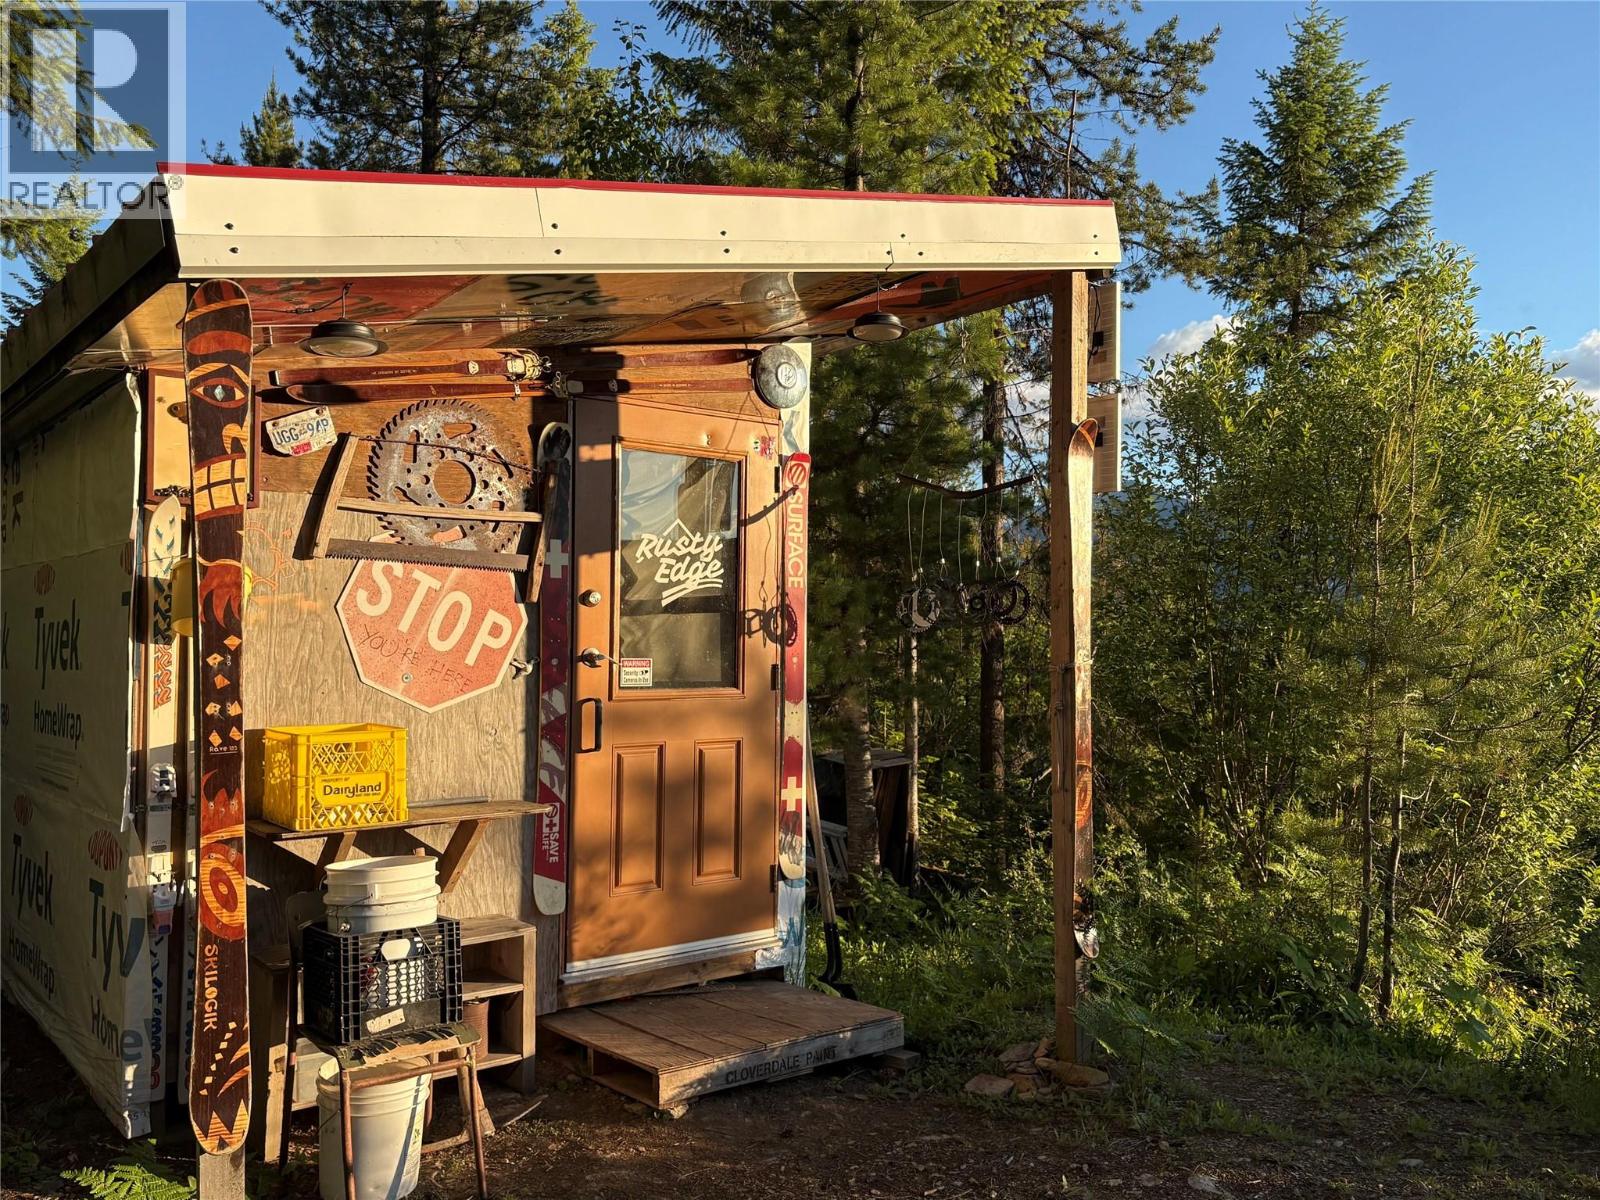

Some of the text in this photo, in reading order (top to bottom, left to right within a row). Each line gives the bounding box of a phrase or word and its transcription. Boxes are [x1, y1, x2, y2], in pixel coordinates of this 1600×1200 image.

[272, 427, 299, 446] UGG
[635, 531, 724, 564] Rusty
[787, 492, 804, 589] SURFACE
[654, 556, 725, 586] Edge
[356, 560, 513, 667] STOP
[34, 597, 81, 690] Tyvek
[34, 698, 83, 751] HomeWrap
[323, 782, 382, 798] Dairyland
[549, 832, 559, 863] SAVE
[11, 833, 54, 925] Tyvek
[8, 928, 55, 994] HomeWrap
[90, 994, 151, 1062] Home
[725, 1046, 837, 1085] CLOVERDALE PAINT
